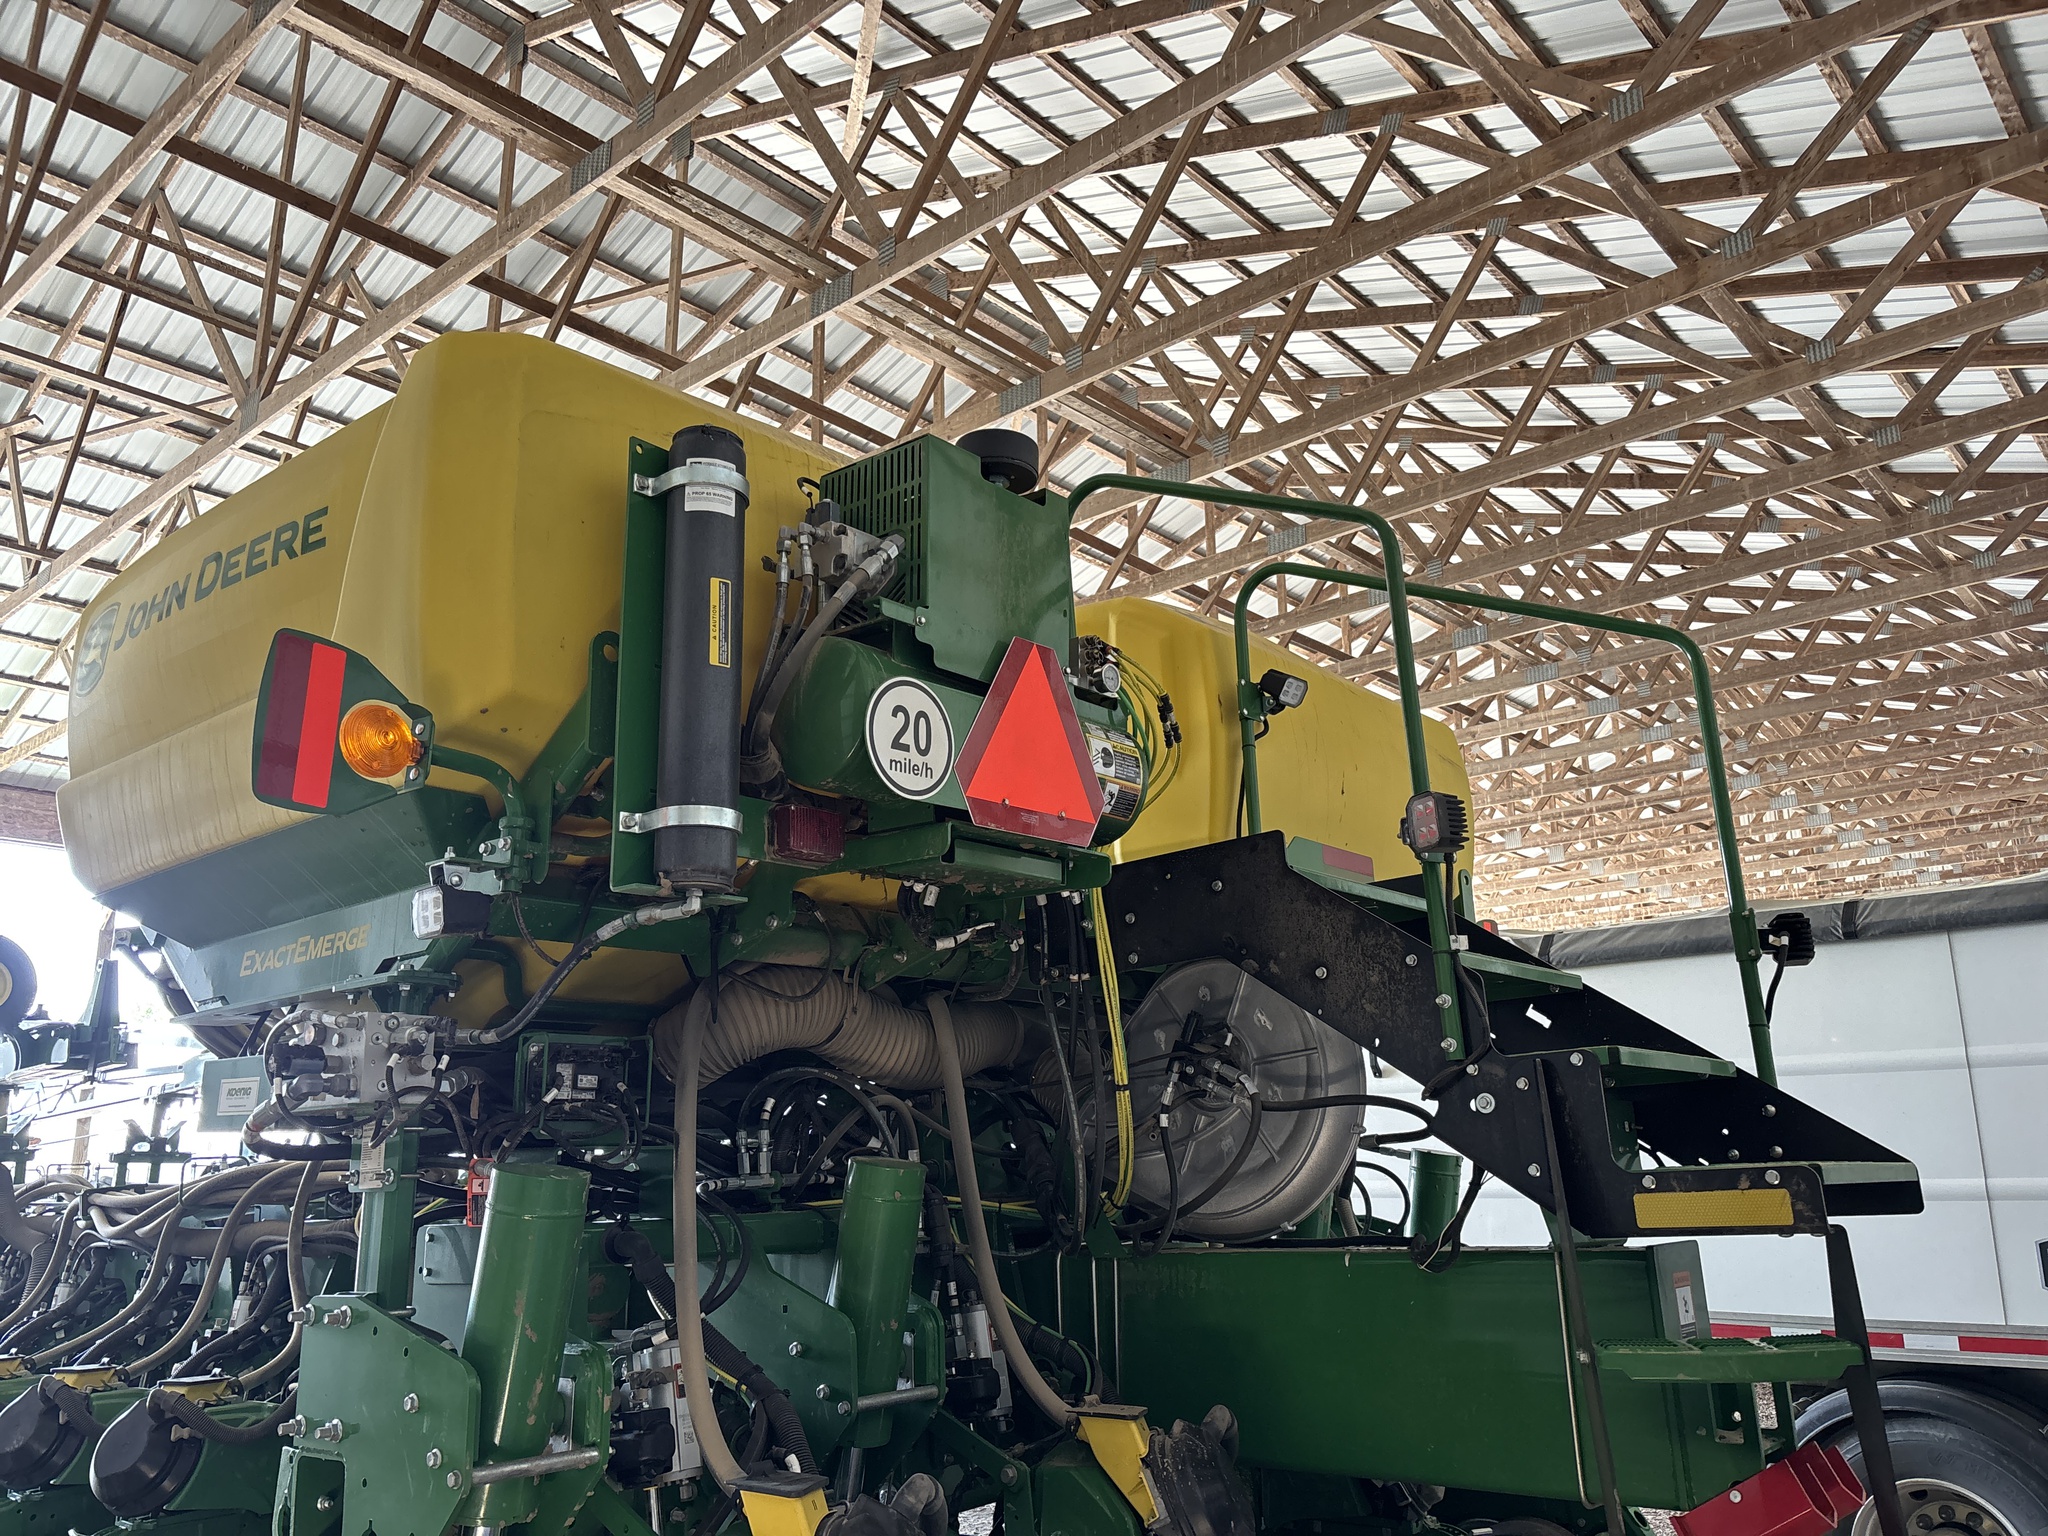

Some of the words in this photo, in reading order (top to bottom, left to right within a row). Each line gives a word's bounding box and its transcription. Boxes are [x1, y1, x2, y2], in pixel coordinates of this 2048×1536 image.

[712, 492, 733, 502] WARNING
[113, 573, 191, 652] JOHN
[194, 505, 329, 603] DEERE
[890, 704, 932, 757] 20
[889, 757, 934, 779] mile/h
